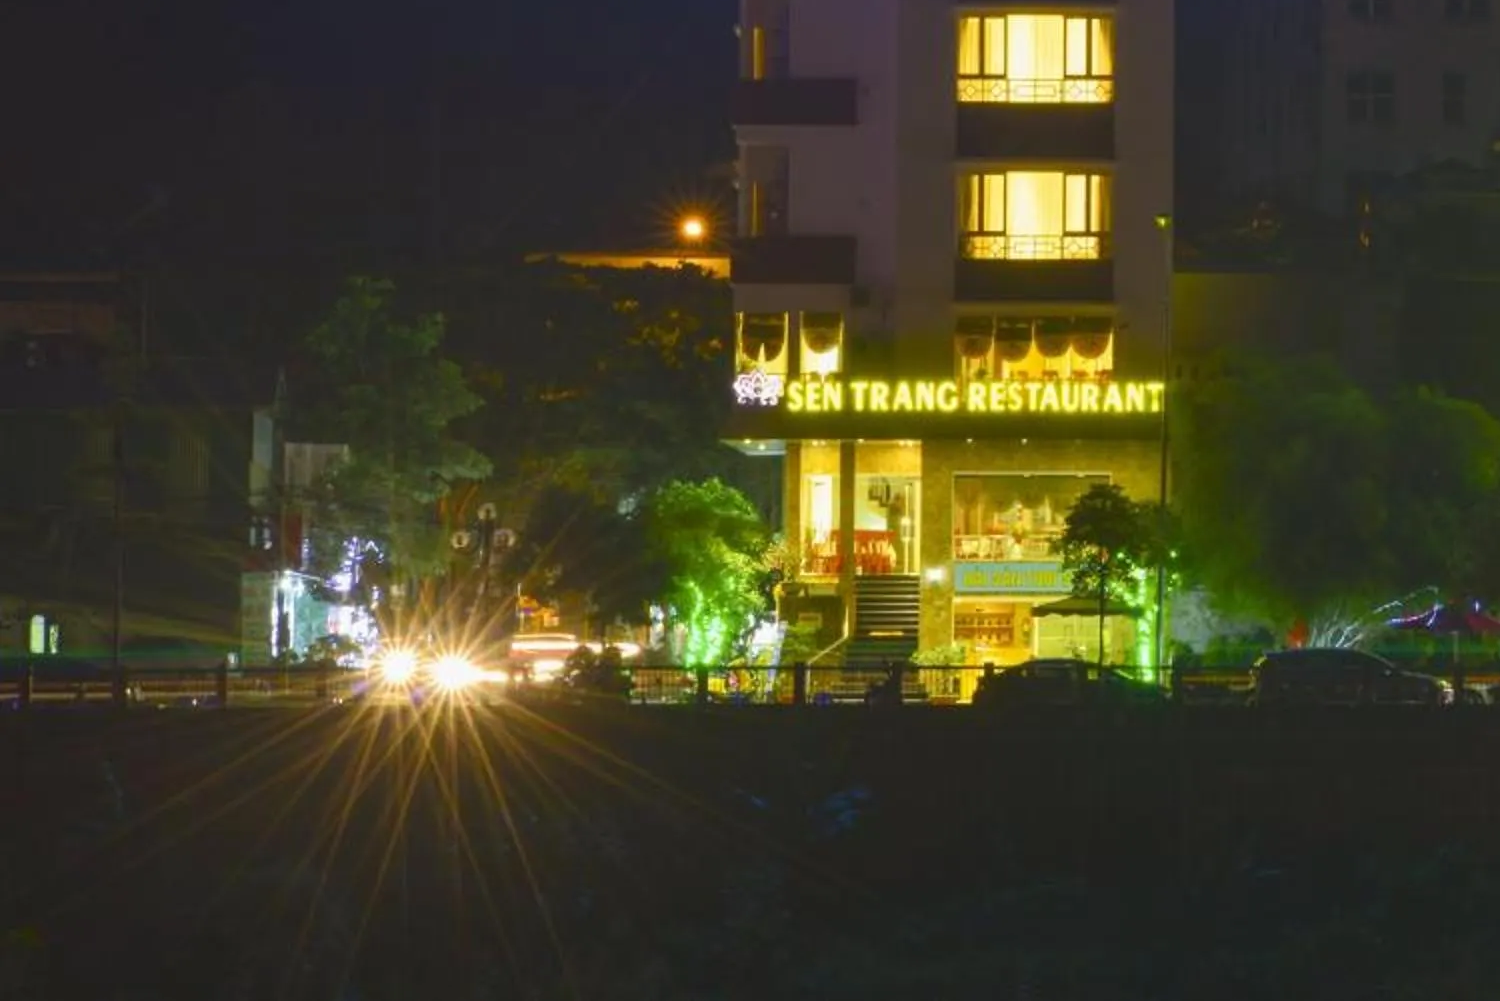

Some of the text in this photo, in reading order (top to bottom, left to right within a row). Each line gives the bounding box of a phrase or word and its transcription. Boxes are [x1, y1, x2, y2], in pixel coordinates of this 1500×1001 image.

[788, 381, 1166, 412] SEN TRANG RESTAURANT
